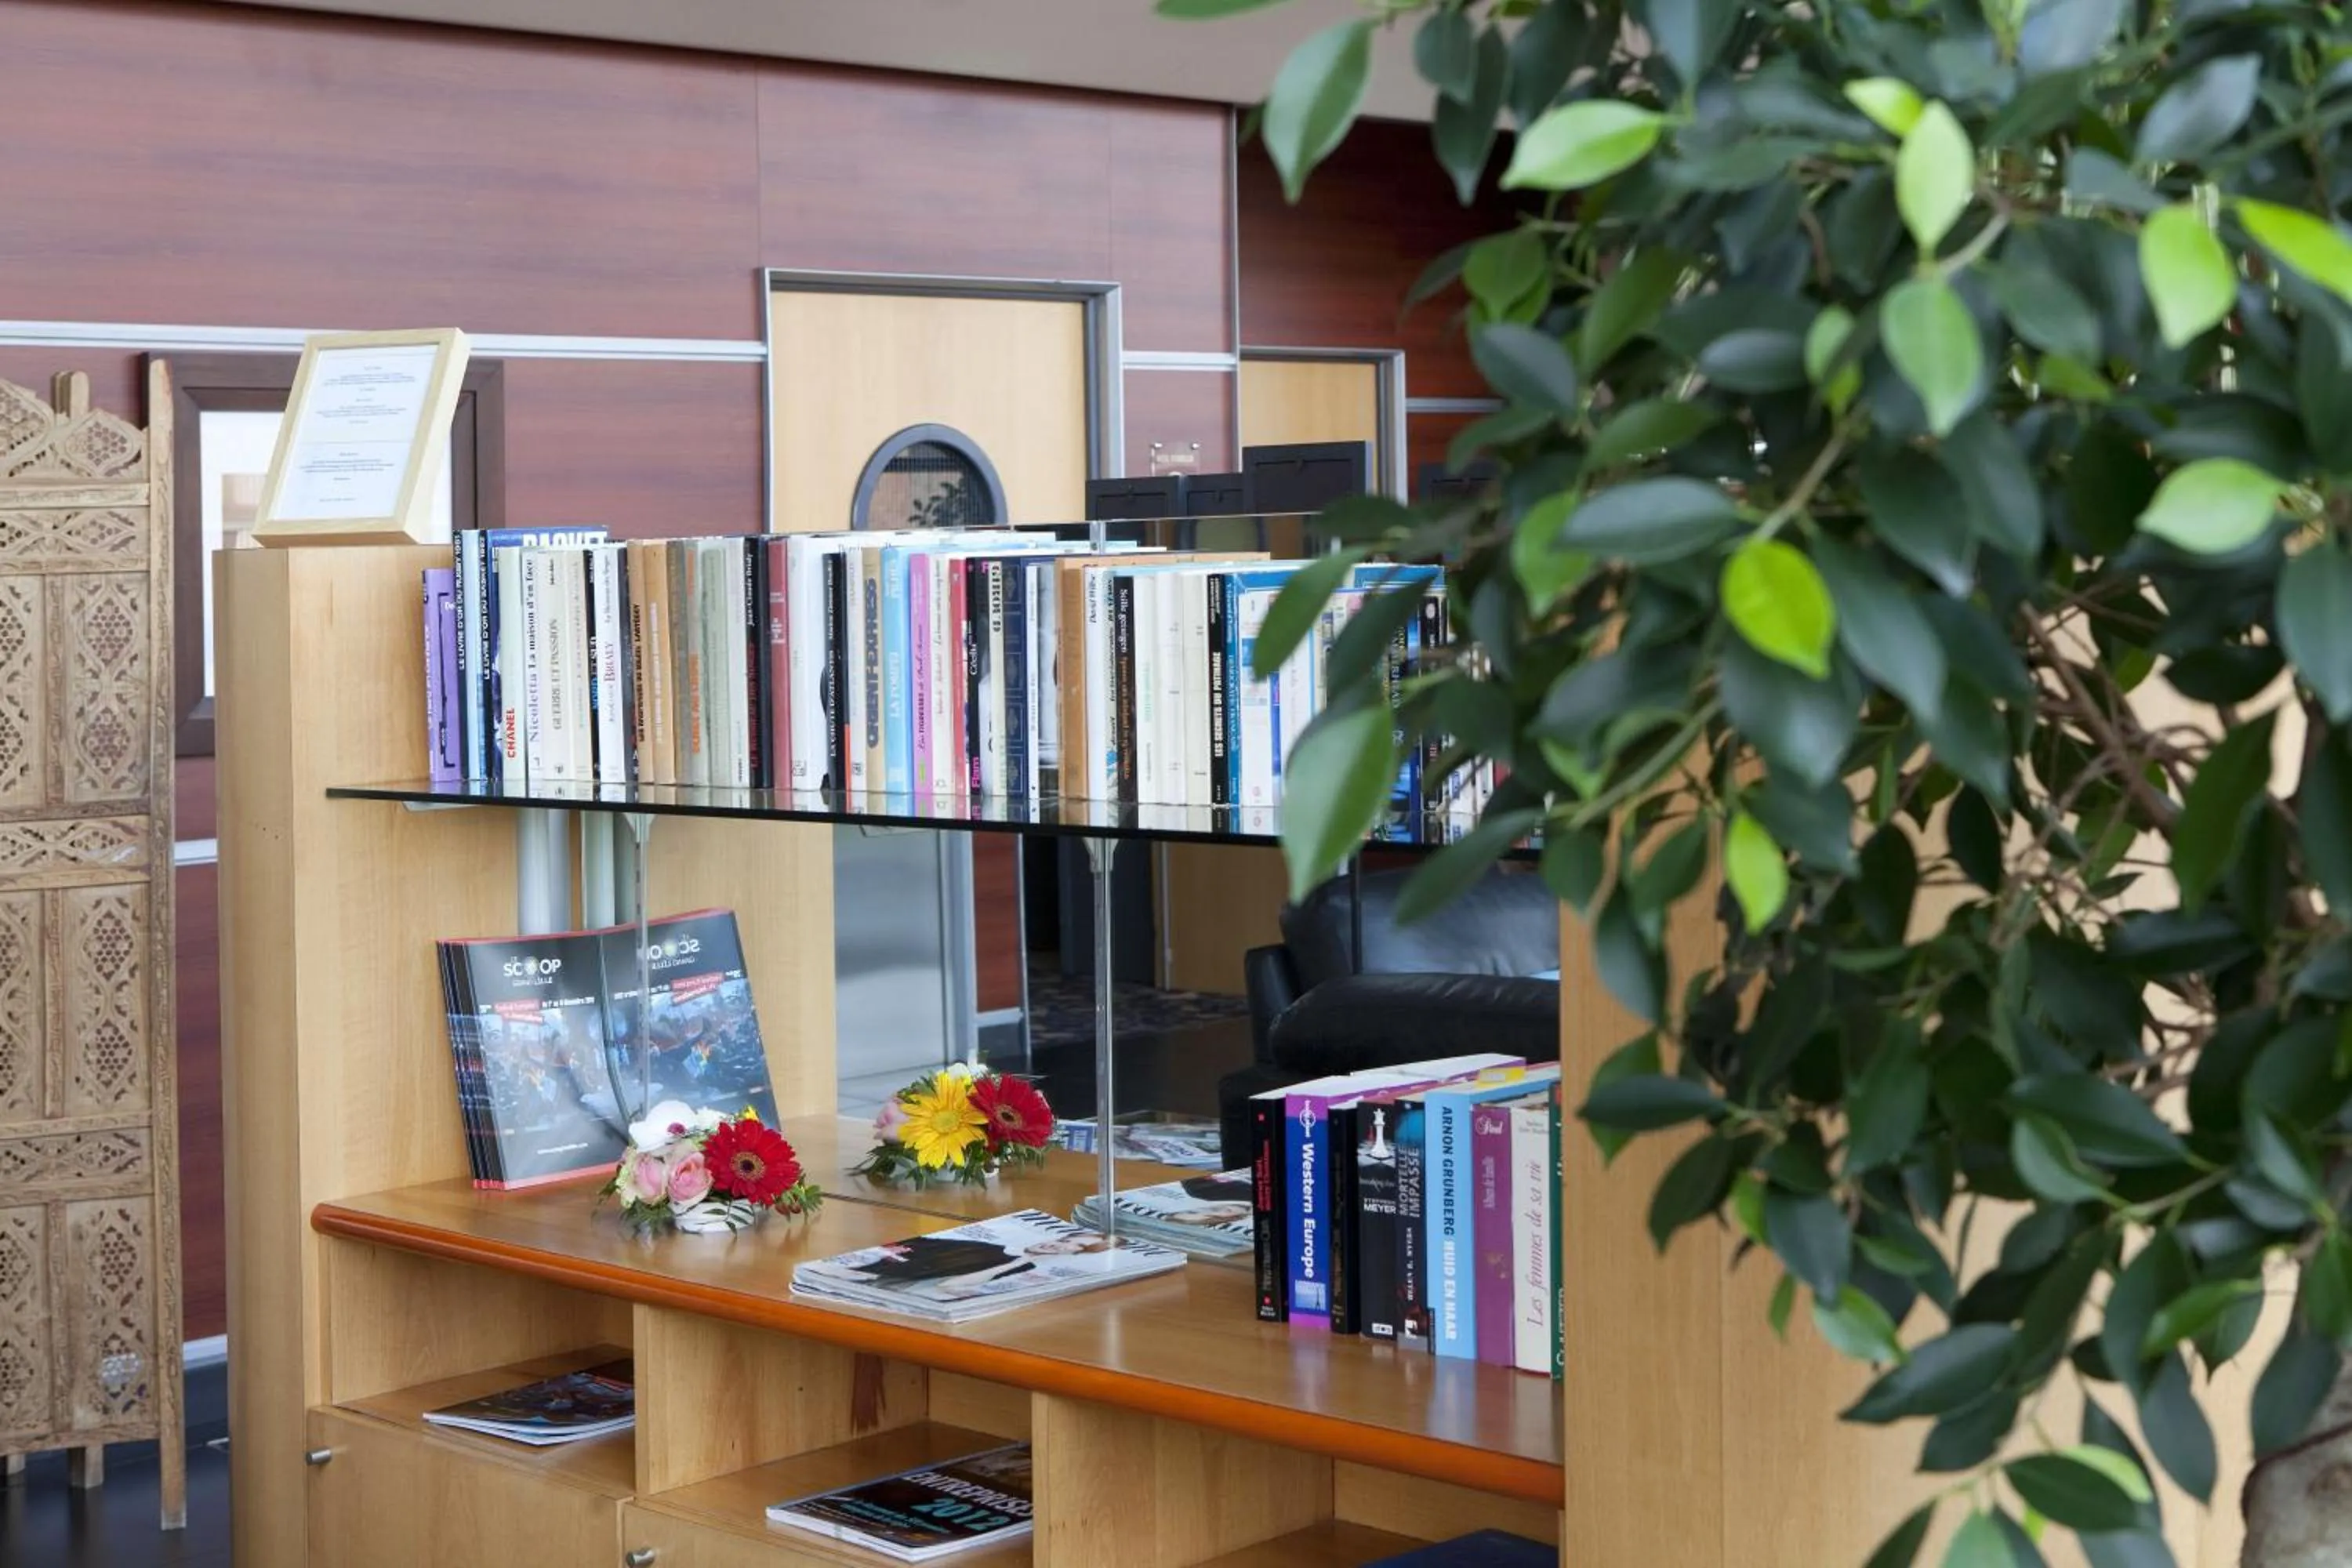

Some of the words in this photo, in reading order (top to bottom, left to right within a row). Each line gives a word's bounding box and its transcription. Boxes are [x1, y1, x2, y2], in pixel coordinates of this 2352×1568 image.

[524, 558, 533, 582] face
[526, 585, 535, 609] d'en
[527, 612, 535, 651] maison
[549, 618, 560, 666] PASSION
[528, 654, 536, 669] La
[1212, 652, 1222, 691] PATINAGE
[528, 673, 540, 742] Nicoletta
[1213, 693, 1222, 706] DU
[506, 708, 516, 758] CHANEL
[1213, 707, 1223, 742] SECRETS
[1214, 743, 1223, 757] LES
[1441, 1106, 1453, 1155] ARNON
[1301, 1142, 1315, 1213] Western
[1398, 1145, 1409, 1216] MORTELLE
[1407, 1147, 1420, 1218] IMPASSE
[1524, 1159, 1542, 1182] vie
[1363, 1203, 1396, 1214] MEYER
[1443, 1158, 1455, 1236] GRUNBERG
[1529, 1189, 1541, 1206] sa
[1524, 1210, 1542, 1228] de
[1301, 1218, 1316, 1279] Europe
[1443, 1240, 1455, 1276] HUID
[1525, 1234, 1549, 1294] femmes
[1444, 1279, 1456, 1298] EN
[1445, 1301, 1457, 1341] HAAR
[1526, 1296, 1544, 1327] Les
